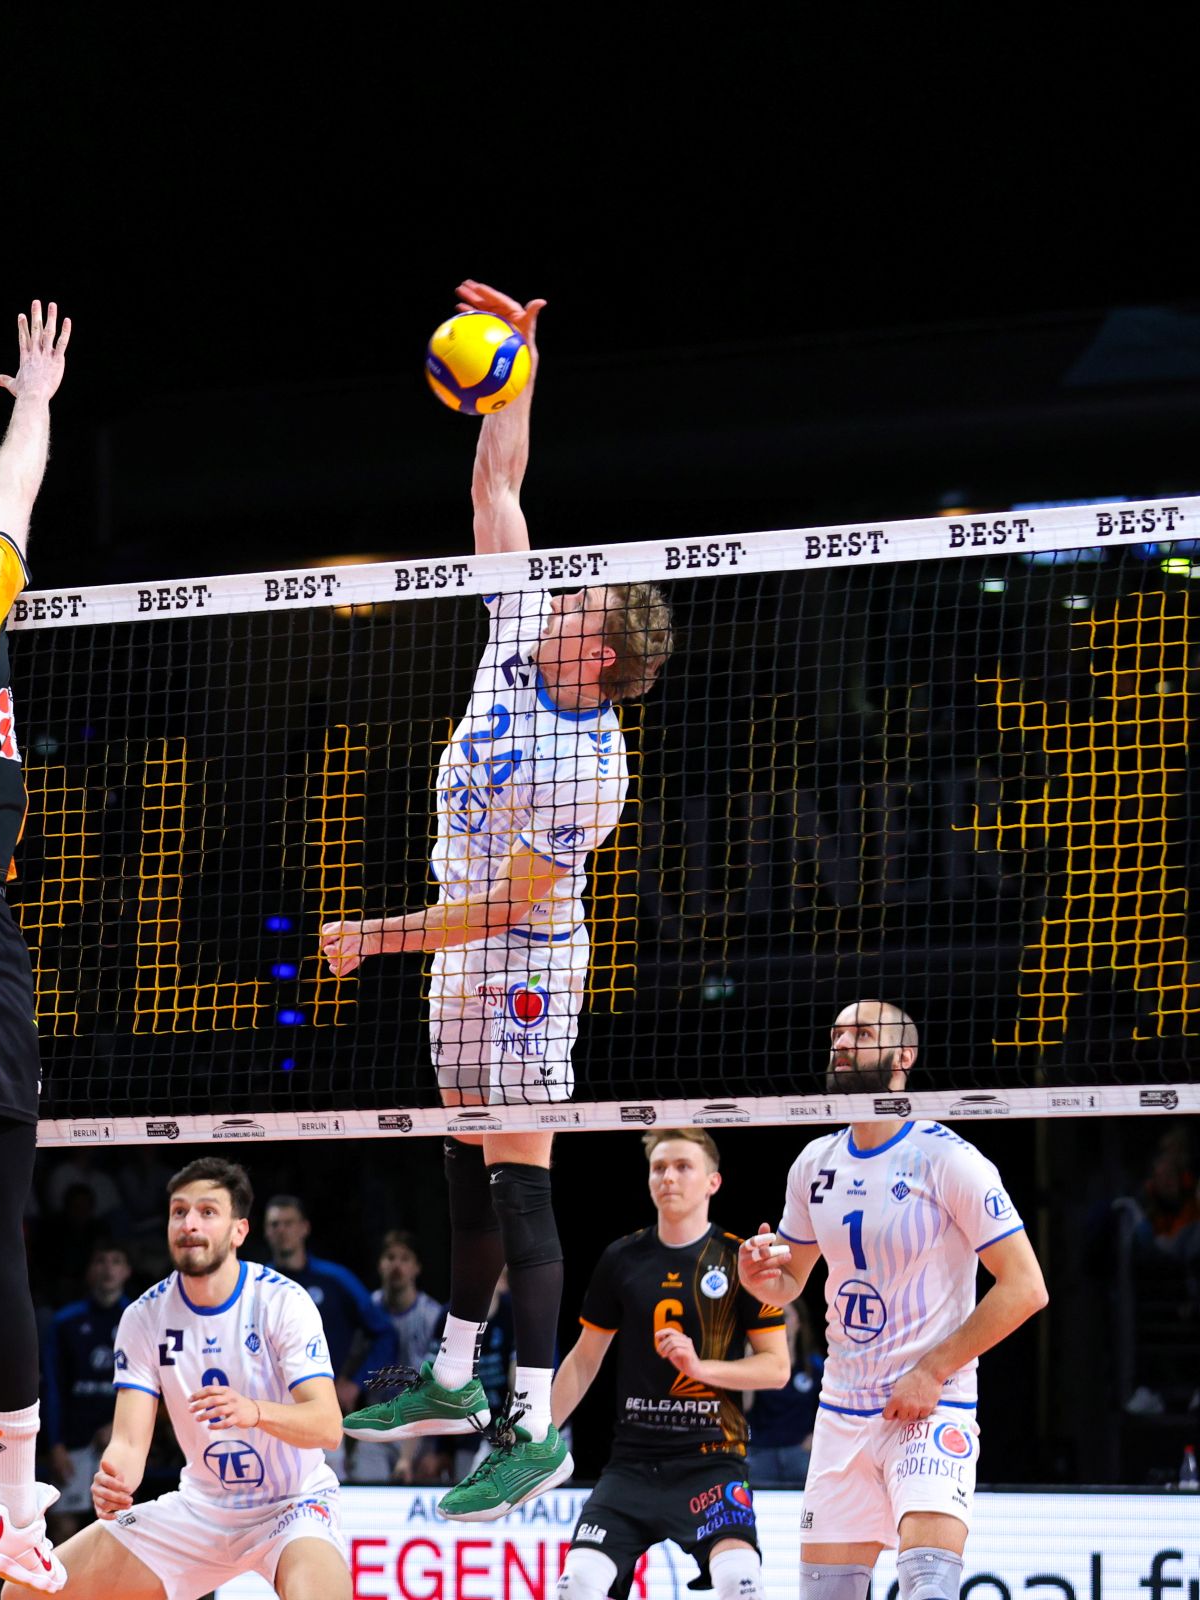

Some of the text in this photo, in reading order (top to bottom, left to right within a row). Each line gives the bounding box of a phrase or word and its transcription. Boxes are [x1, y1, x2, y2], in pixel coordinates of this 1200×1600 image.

[1051, 1098, 1080, 1107] BERLIN
[790, 1107, 817, 1116] BERLIN
[540, 1115, 567, 1123] BERLIN
[73, 1129, 97, 1138] BERLIN
[302, 1122, 327, 1131] BERLIN
[842, 1210, 867, 1270] 1
[834, 1291, 885, 1335] ZF
[625, 1397, 720, 1414] BELLGARDT
[905, 1442, 926, 1456] VOM
[204, 1446, 264, 1487] ZF
[690, 1484, 724, 1515] OBST
